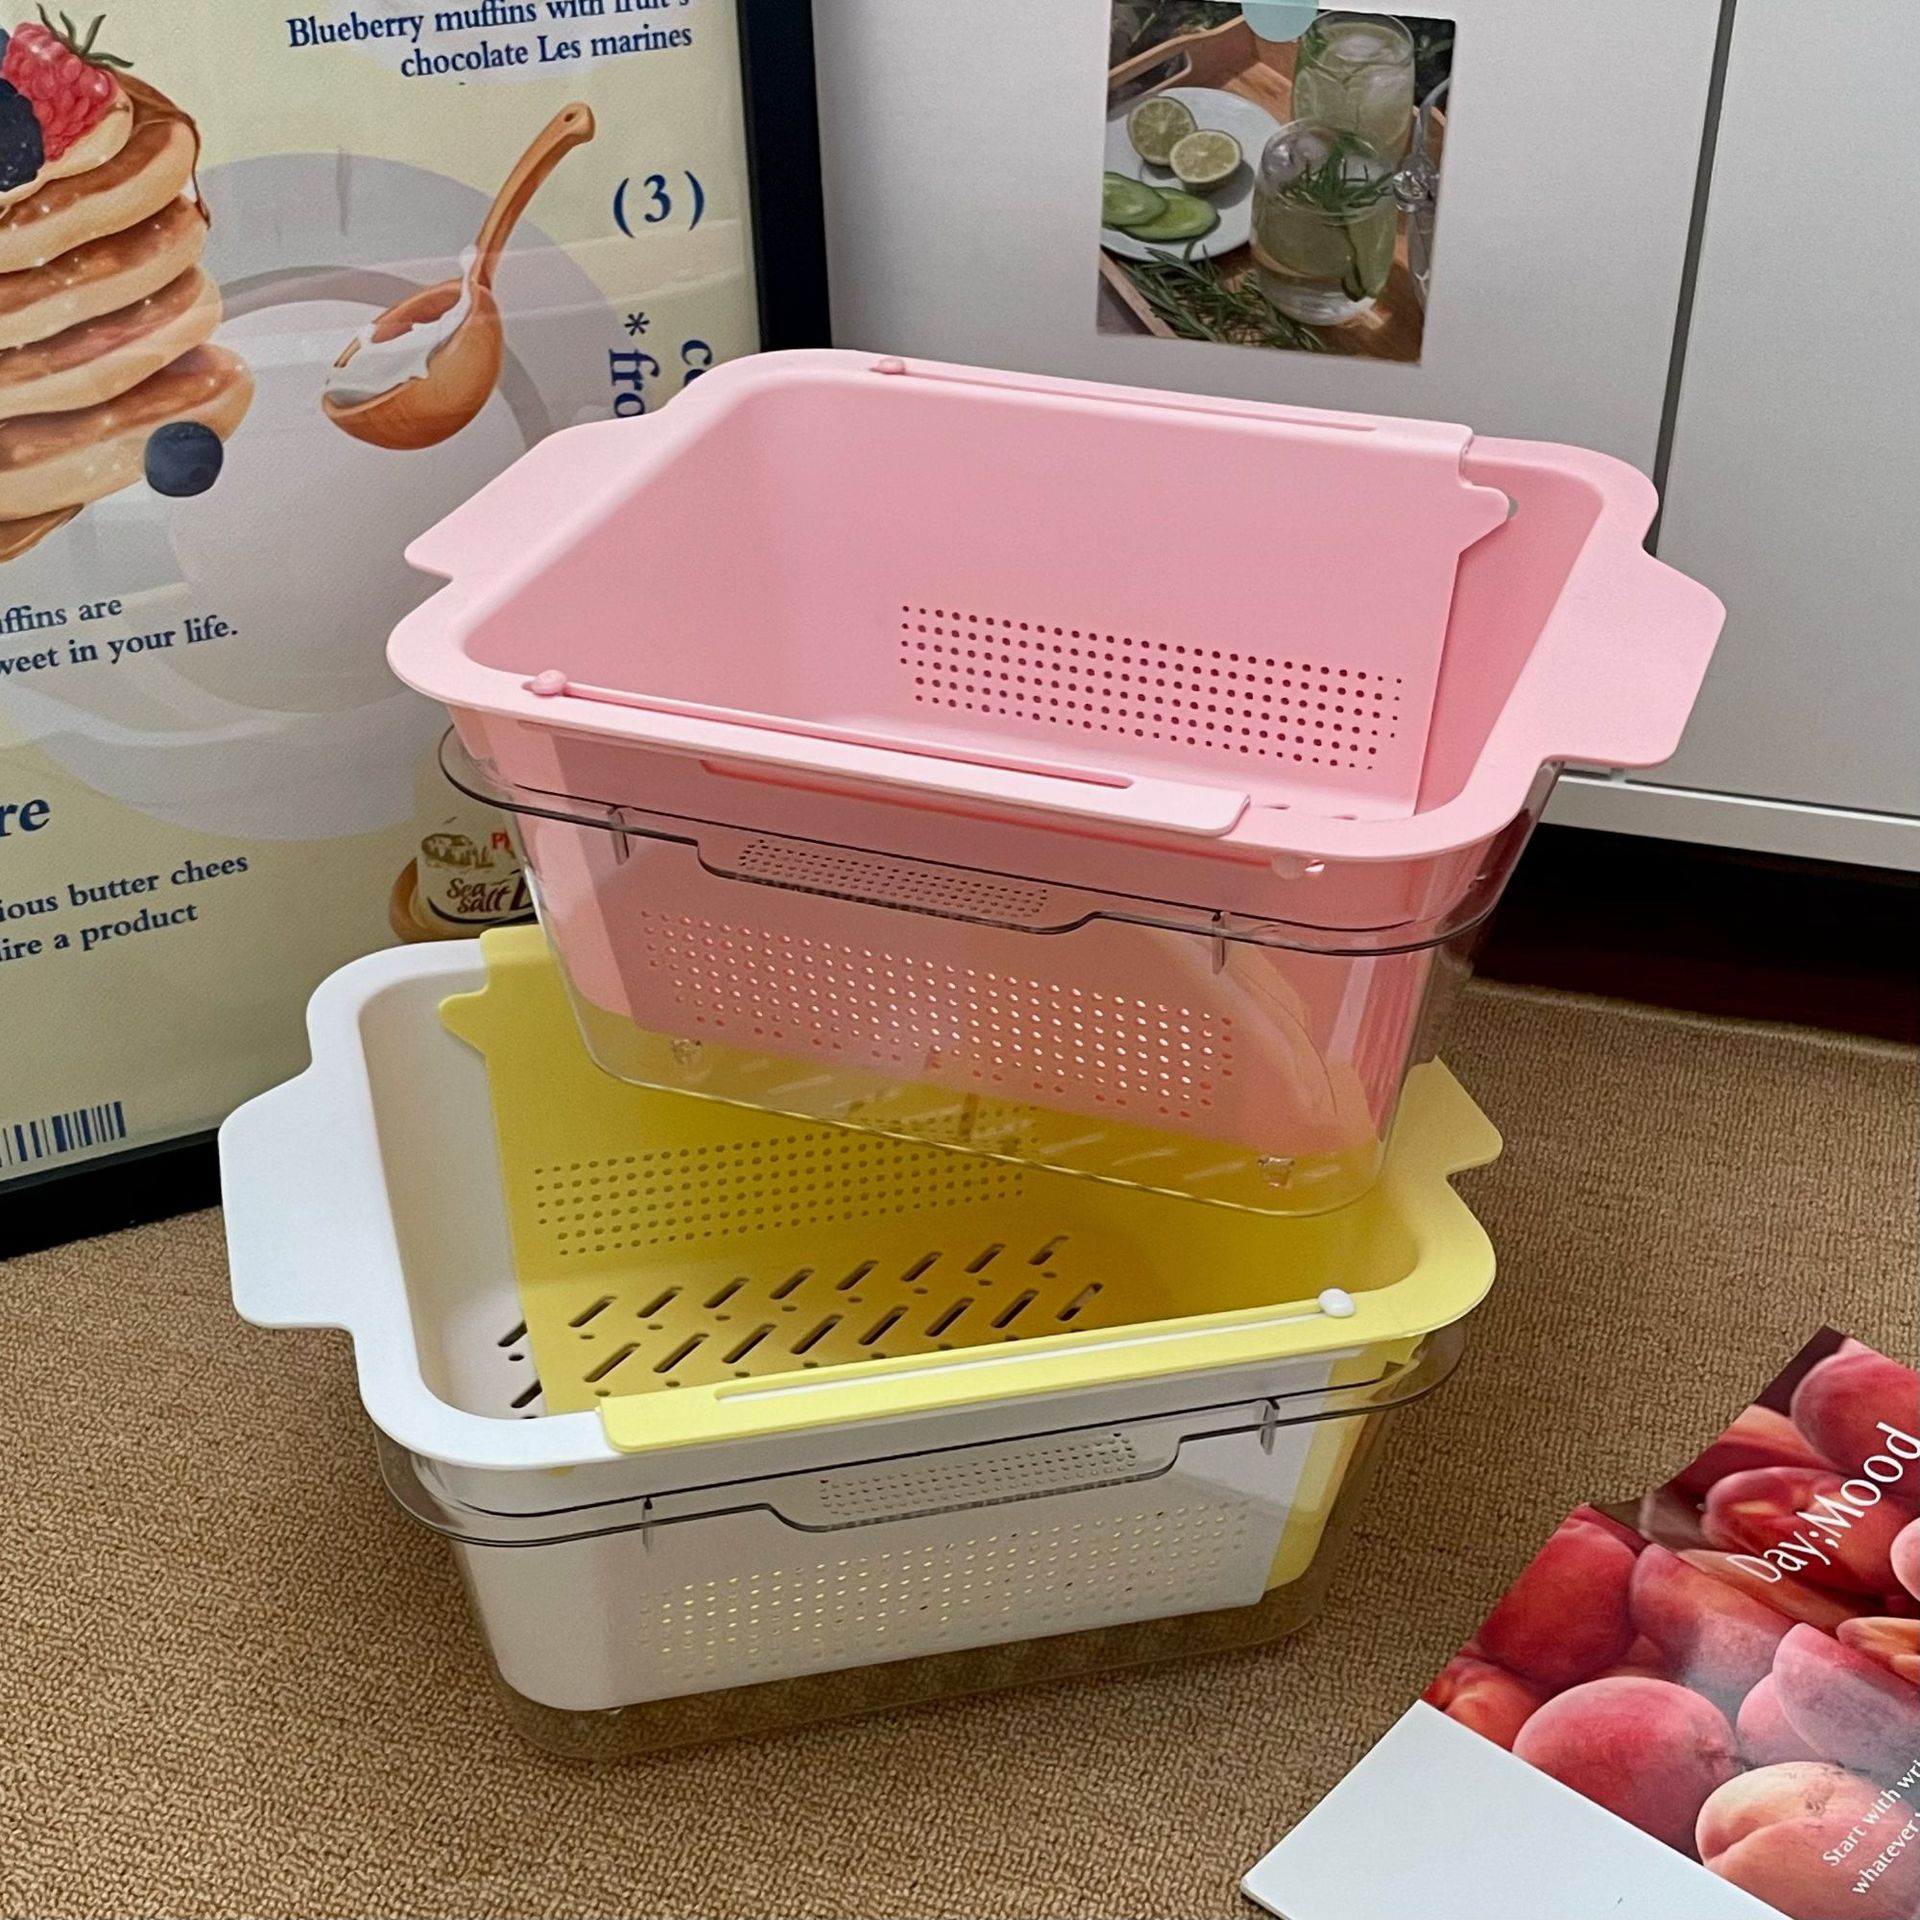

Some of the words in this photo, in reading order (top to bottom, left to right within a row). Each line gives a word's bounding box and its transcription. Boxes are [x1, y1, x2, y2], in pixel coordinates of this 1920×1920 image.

[286, 11, 424, 47] Blueberry
[435, 0, 537, 31] muffins
[401, 40, 528, 77] chocolate
[537, 35, 581, 63] Les
[591, 23, 693, 58] marines
[0, 605, 67, 634] ffins
[79, 599, 122, 621] are
[68, 639, 98, 664] in
[108, 630, 176, 664] your
[184, 614, 238, 644] life.
[67, 874, 160, 907] butter
[171, 856, 248, 885] chees
[446, 877, 486, 899] Sea
[54, 933, 70, 950] a
[80, 904, 198, 951] product
[1726, 1421, 1920, 1583] Day;Mood
[1822, 1824, 1867, 1867] Start
[1862, 1789, 1902, 1826] with
[1852, 1819, 1919, 1894] whatever
